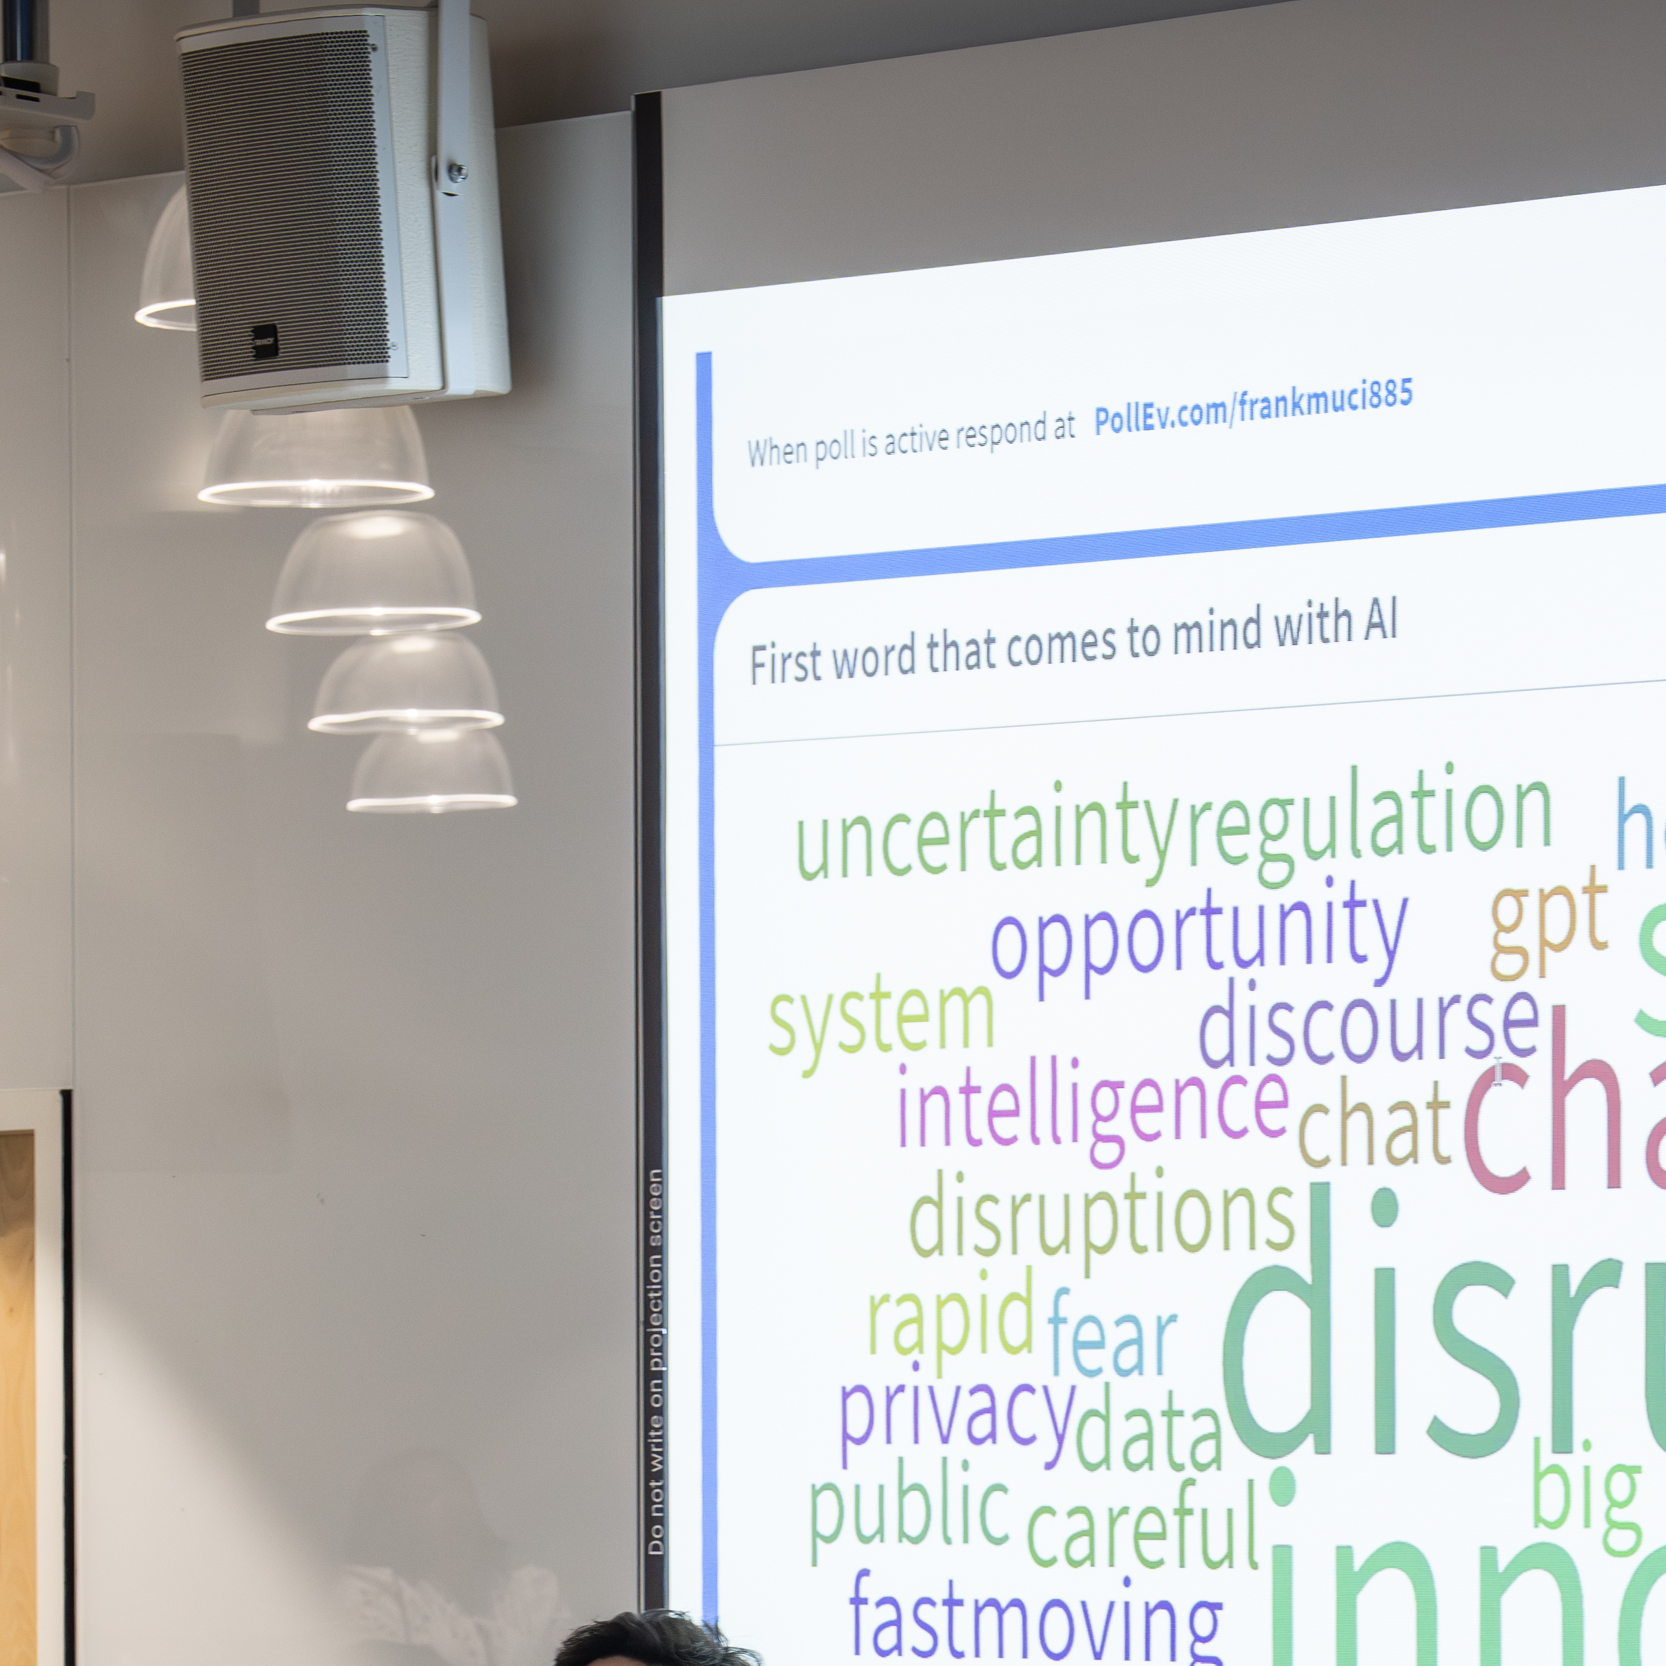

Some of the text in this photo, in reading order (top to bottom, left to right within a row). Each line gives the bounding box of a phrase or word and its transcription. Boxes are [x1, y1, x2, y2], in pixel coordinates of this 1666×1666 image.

[748, 377, 1413, 469] When poll is active respond at PollEv.com/frankmuci885
[752, 596, 1397, 685] First word that comes to mind with AI
[798, 780, 1179, 888] uncertainty
[1190, 761, 1551, 890] regulation
[991, 874, 1409, 1002] opportunity
[1490, 865, 1609, 982] gpt
[769, 972, 993, 1079] system
[1199, 976, 1539, 1069] discourse
[899, 1055, 1289, 1170] intelligence
[1298, 1075, 1452, 1169] chat
[910, 1165, 1295, 1281] disruptions
[646, 1168, 668, 1555] Do not write on projection screen
[870, 1265, 1032, 1379] rapid
[1047, 1286, 1178, 1378] fear
[841, 1360, 1077, 1472] privacy
[1076, 1381, 1222, 1472] data
[811, 1456, 1010, 1567] public
[1027, 1477, 1259, 1570] careful
[1533, 1436, 1643, 1558] big
